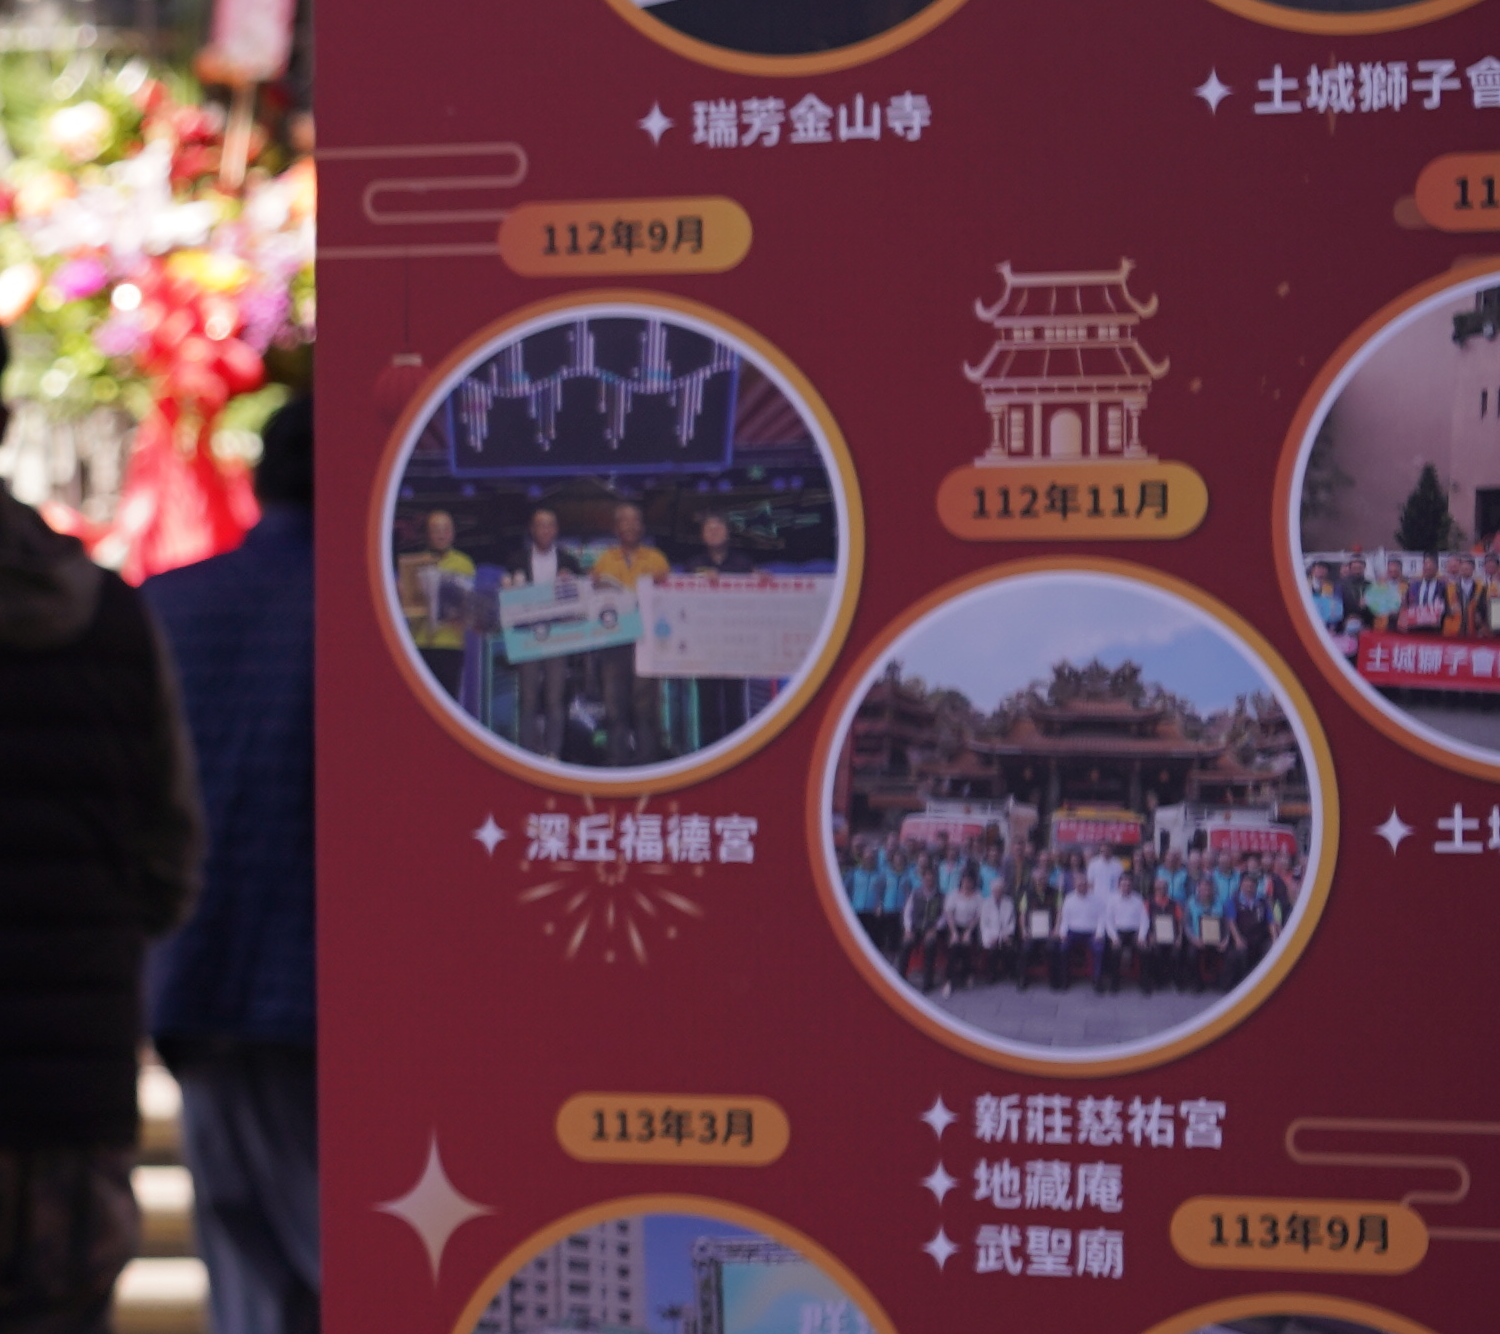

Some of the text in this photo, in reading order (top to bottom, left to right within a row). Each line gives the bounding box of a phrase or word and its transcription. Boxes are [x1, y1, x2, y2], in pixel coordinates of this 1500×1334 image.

[692, 90, 932, 149] 瑞芳金山寺
[542, 215, 704, 257] 112年9月
[971, 480, 1169, 521] 112年11月
[526, 812, 758, 864] 深丘福德宮
[592, 1107, 755, 1148] 113年3月
[975, 1092, 1227, 1149] 新莊慈祐宮
[973, 1158, 1123, 1213] 地藏庵
[975, 1224, 1124, 1279] 武聖廟
[1210, 1212, 1390, 1255] 113年9月
